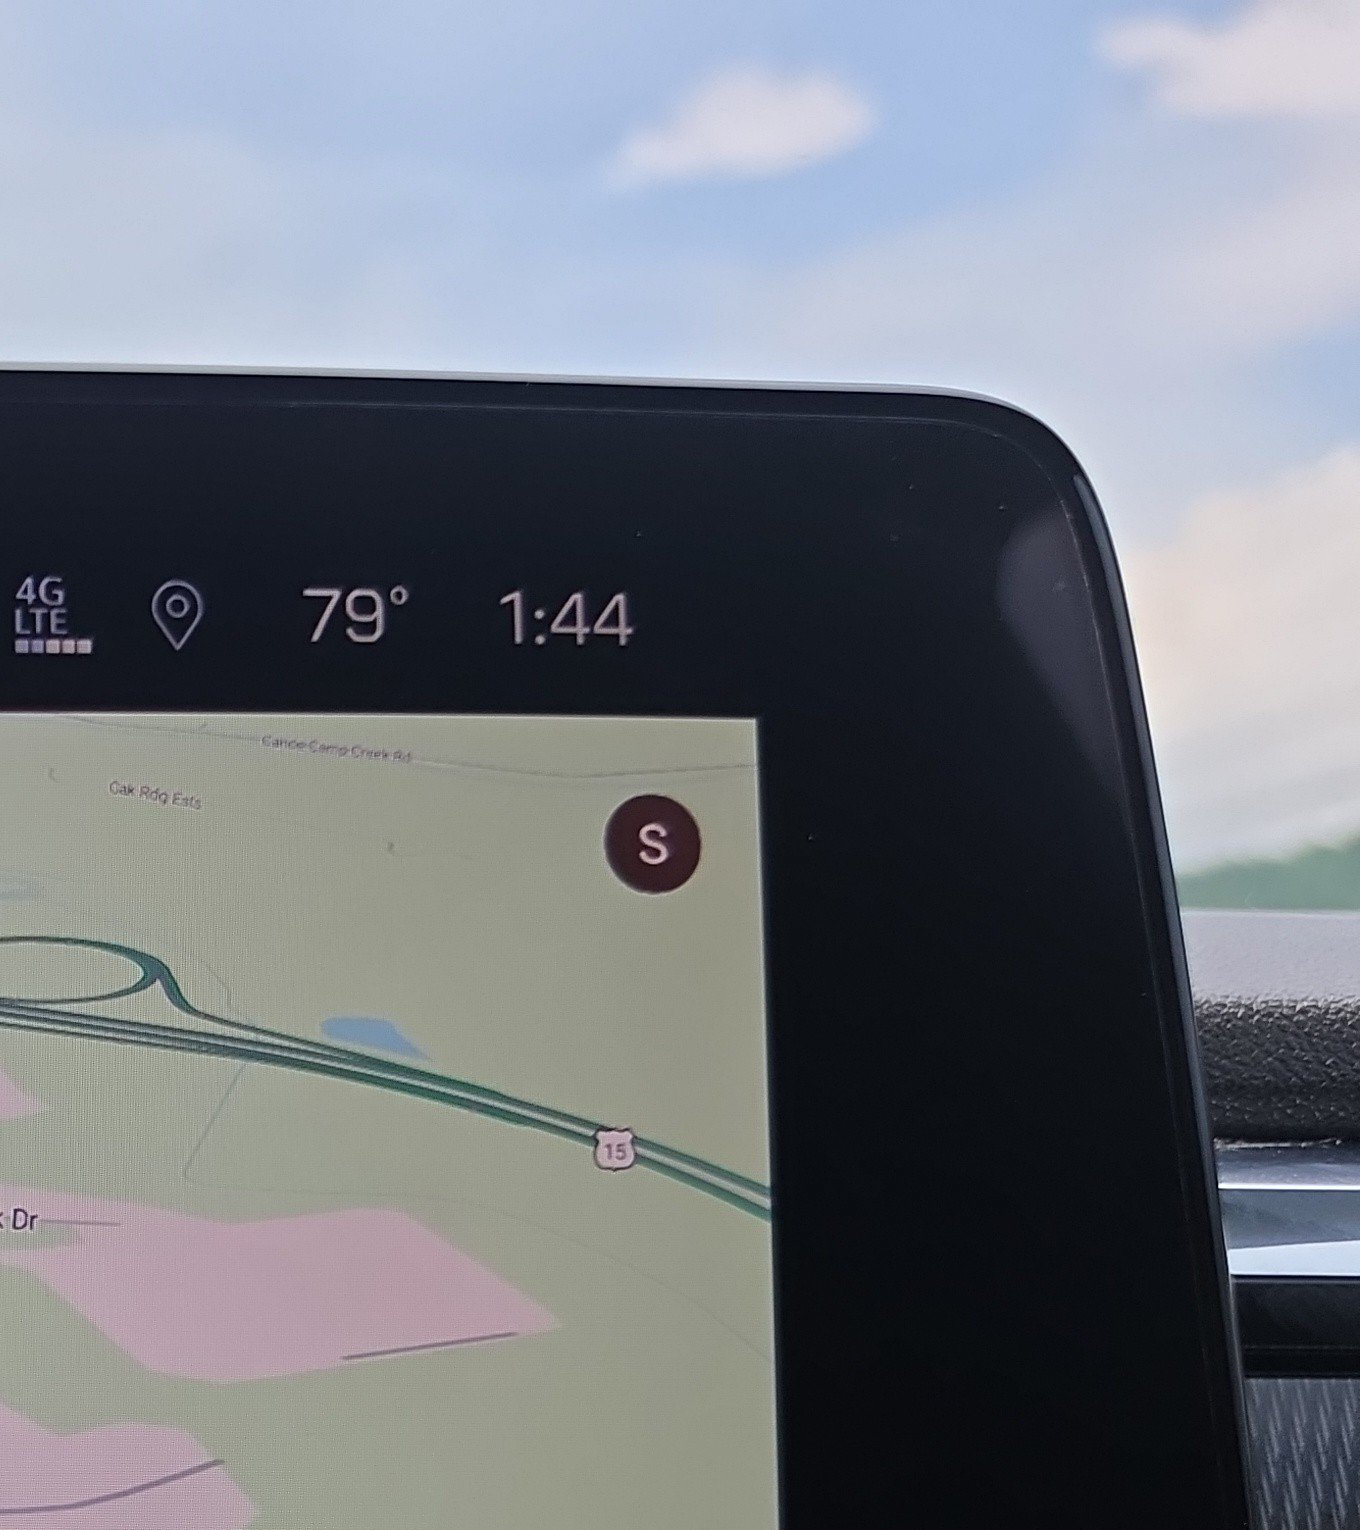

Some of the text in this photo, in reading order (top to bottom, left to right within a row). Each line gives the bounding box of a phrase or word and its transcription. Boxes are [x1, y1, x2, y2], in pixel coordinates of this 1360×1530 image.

[14, 576, 65, 606] 4G
[14, 607, 68, 636] LTE
[301, 586, 410, 645] 79°
[499, 590, 635, 647] 1:44
[109, 780, 135, 796] Oak
[637, 824, 670, 865] S
[604, 1141, 627, 1161] 15
[11, 1208, 39, 1232] Dr
